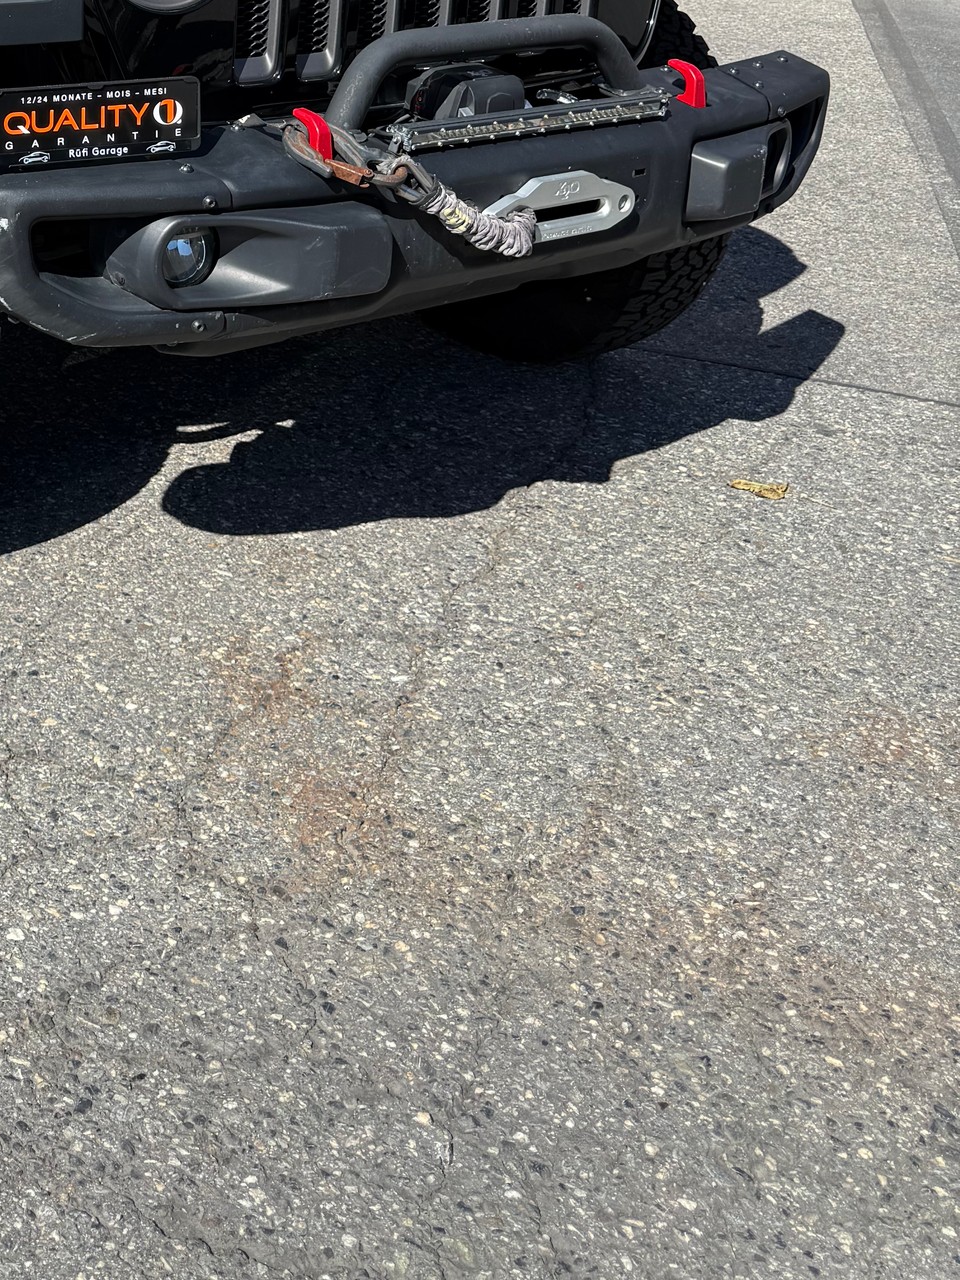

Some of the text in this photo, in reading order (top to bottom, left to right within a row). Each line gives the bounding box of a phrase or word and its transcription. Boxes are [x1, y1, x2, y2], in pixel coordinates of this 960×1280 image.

[21, 96, 48, 104] 12/24
[53, 93, 93, 102] MONATE
[106, 90, 131, 99] MOIS
[144, 88, 167, 96] MESI
[3, 103, 150, 135] QUALITY
[5, 128, 182, 150] GARANTIE
[69, 146, 129, 158] Rüfi Garage
